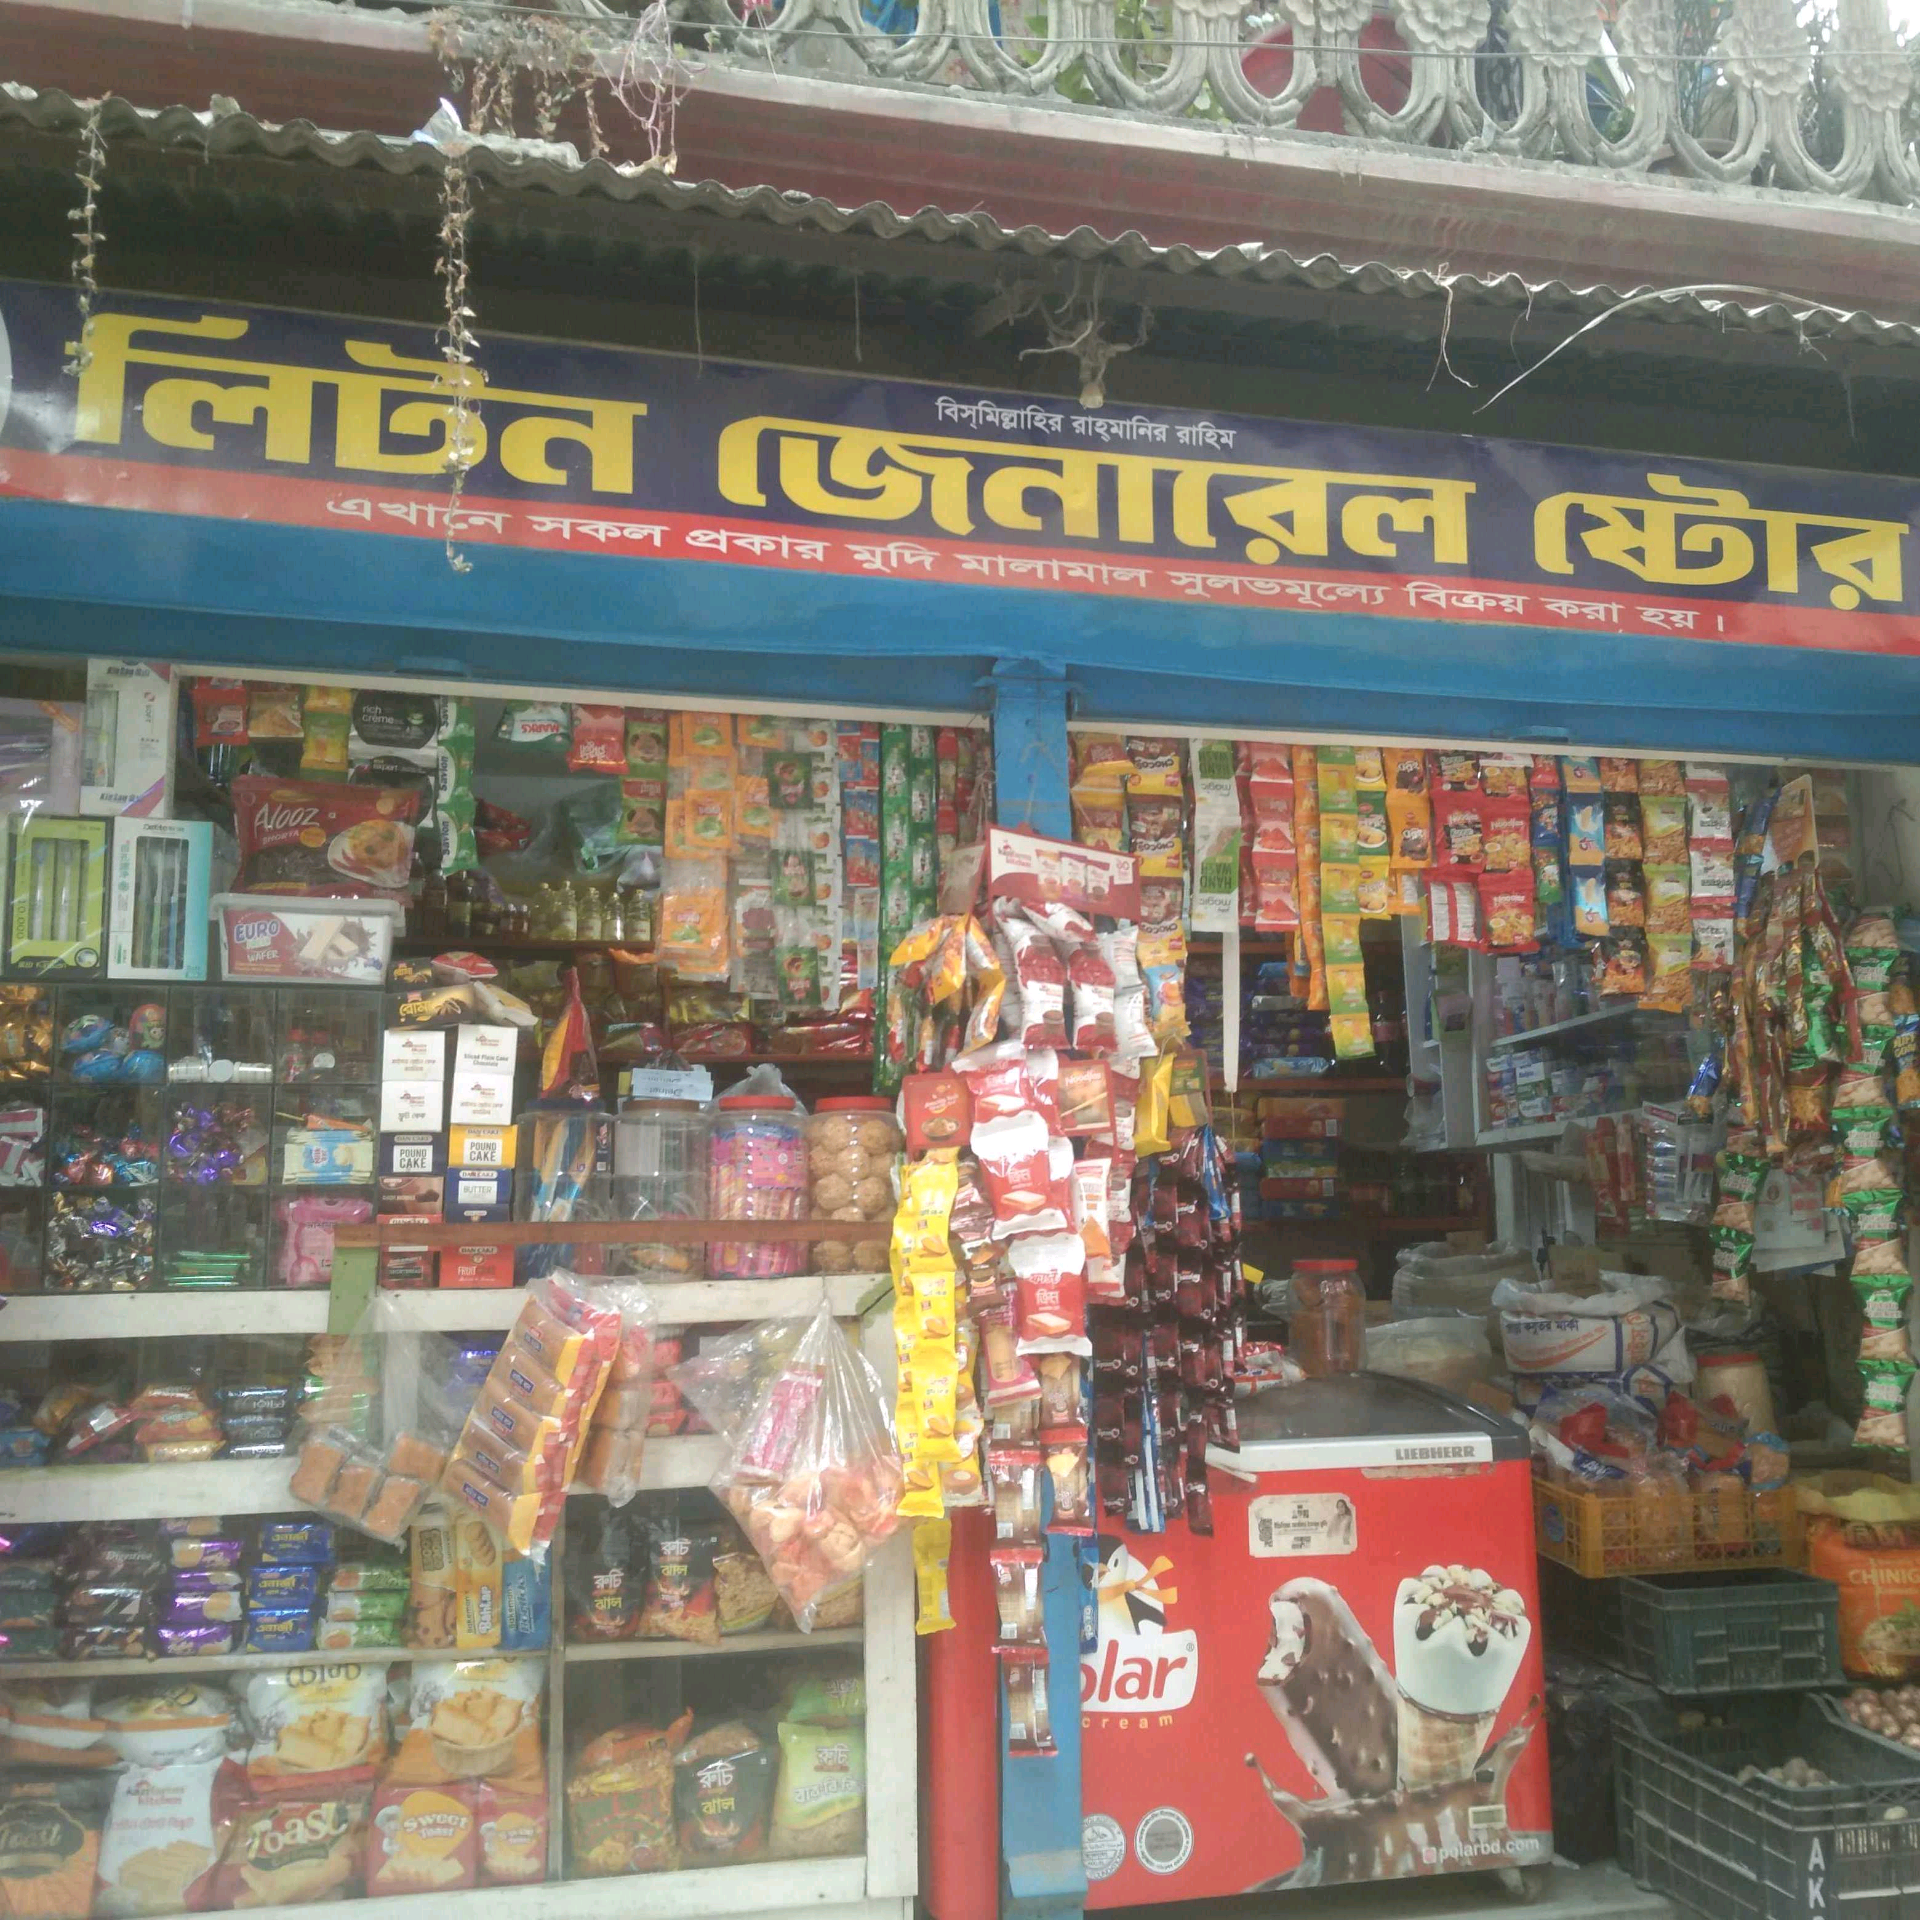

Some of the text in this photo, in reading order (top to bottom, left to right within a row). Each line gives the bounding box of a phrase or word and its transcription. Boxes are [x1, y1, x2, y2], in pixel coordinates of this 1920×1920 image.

[66, 313, 648, 494] লিটন
[716, 414, 1477, 566] জেনারেল
[1175, 420, 1238, 451] রাহিম
[326, 498, 514, 535] এখানে
[533, 514, 670, 547] সকল
[685, 525, 832, 563] প্রকার
[847, 540, 941, 573] মুদি
[954, 552, 1153, 589] মালামাল
[1164, 568, 1391, 607] সুলভমূল্যে
[1402, 580, 1530, 616] বিক্রয়
[1541, 596, 1622, 624] করা
[1636, 605, 1700, 632] হয়
[440, 755, 449, 791] Savlon
[441, 820, 450, 856] Savlon
[1200, 875, 1232, 889] HAND
[1199, 897, 1232, 907] magic
[234, 919, 281, 943] EURO
[247, 949, 280, 963] WAFER
[399, 1149, 427, 1158] POUND
[470, 1142, 497, 1151] POUND
[399, 1158, 427, 1169] CAKE
[469, 1151, 496, 1162] CAKE
[458, 1266, 476, 1275] FRUIT
[1395, 1444, 1476, 1461] LIEBHERR
[660, 1537, 692, 1556] রুচি
[593, 1567, 625, 1590] রুচি
[660, 1564, 688, 1576] ঝাল
[594, 1596, 622, 1610] ঝাল
[1080, 1638, 1188, 1703] olar
[1082, 1713, 1174, 1730] cream
[816, 1743, 850, 1765] রুচি
[697, 1760, 736, 1789] রুচি
[701, 1796, 735, 1815] ঝাল
[1439, 1837, 1540, 1864] polarbd.com
